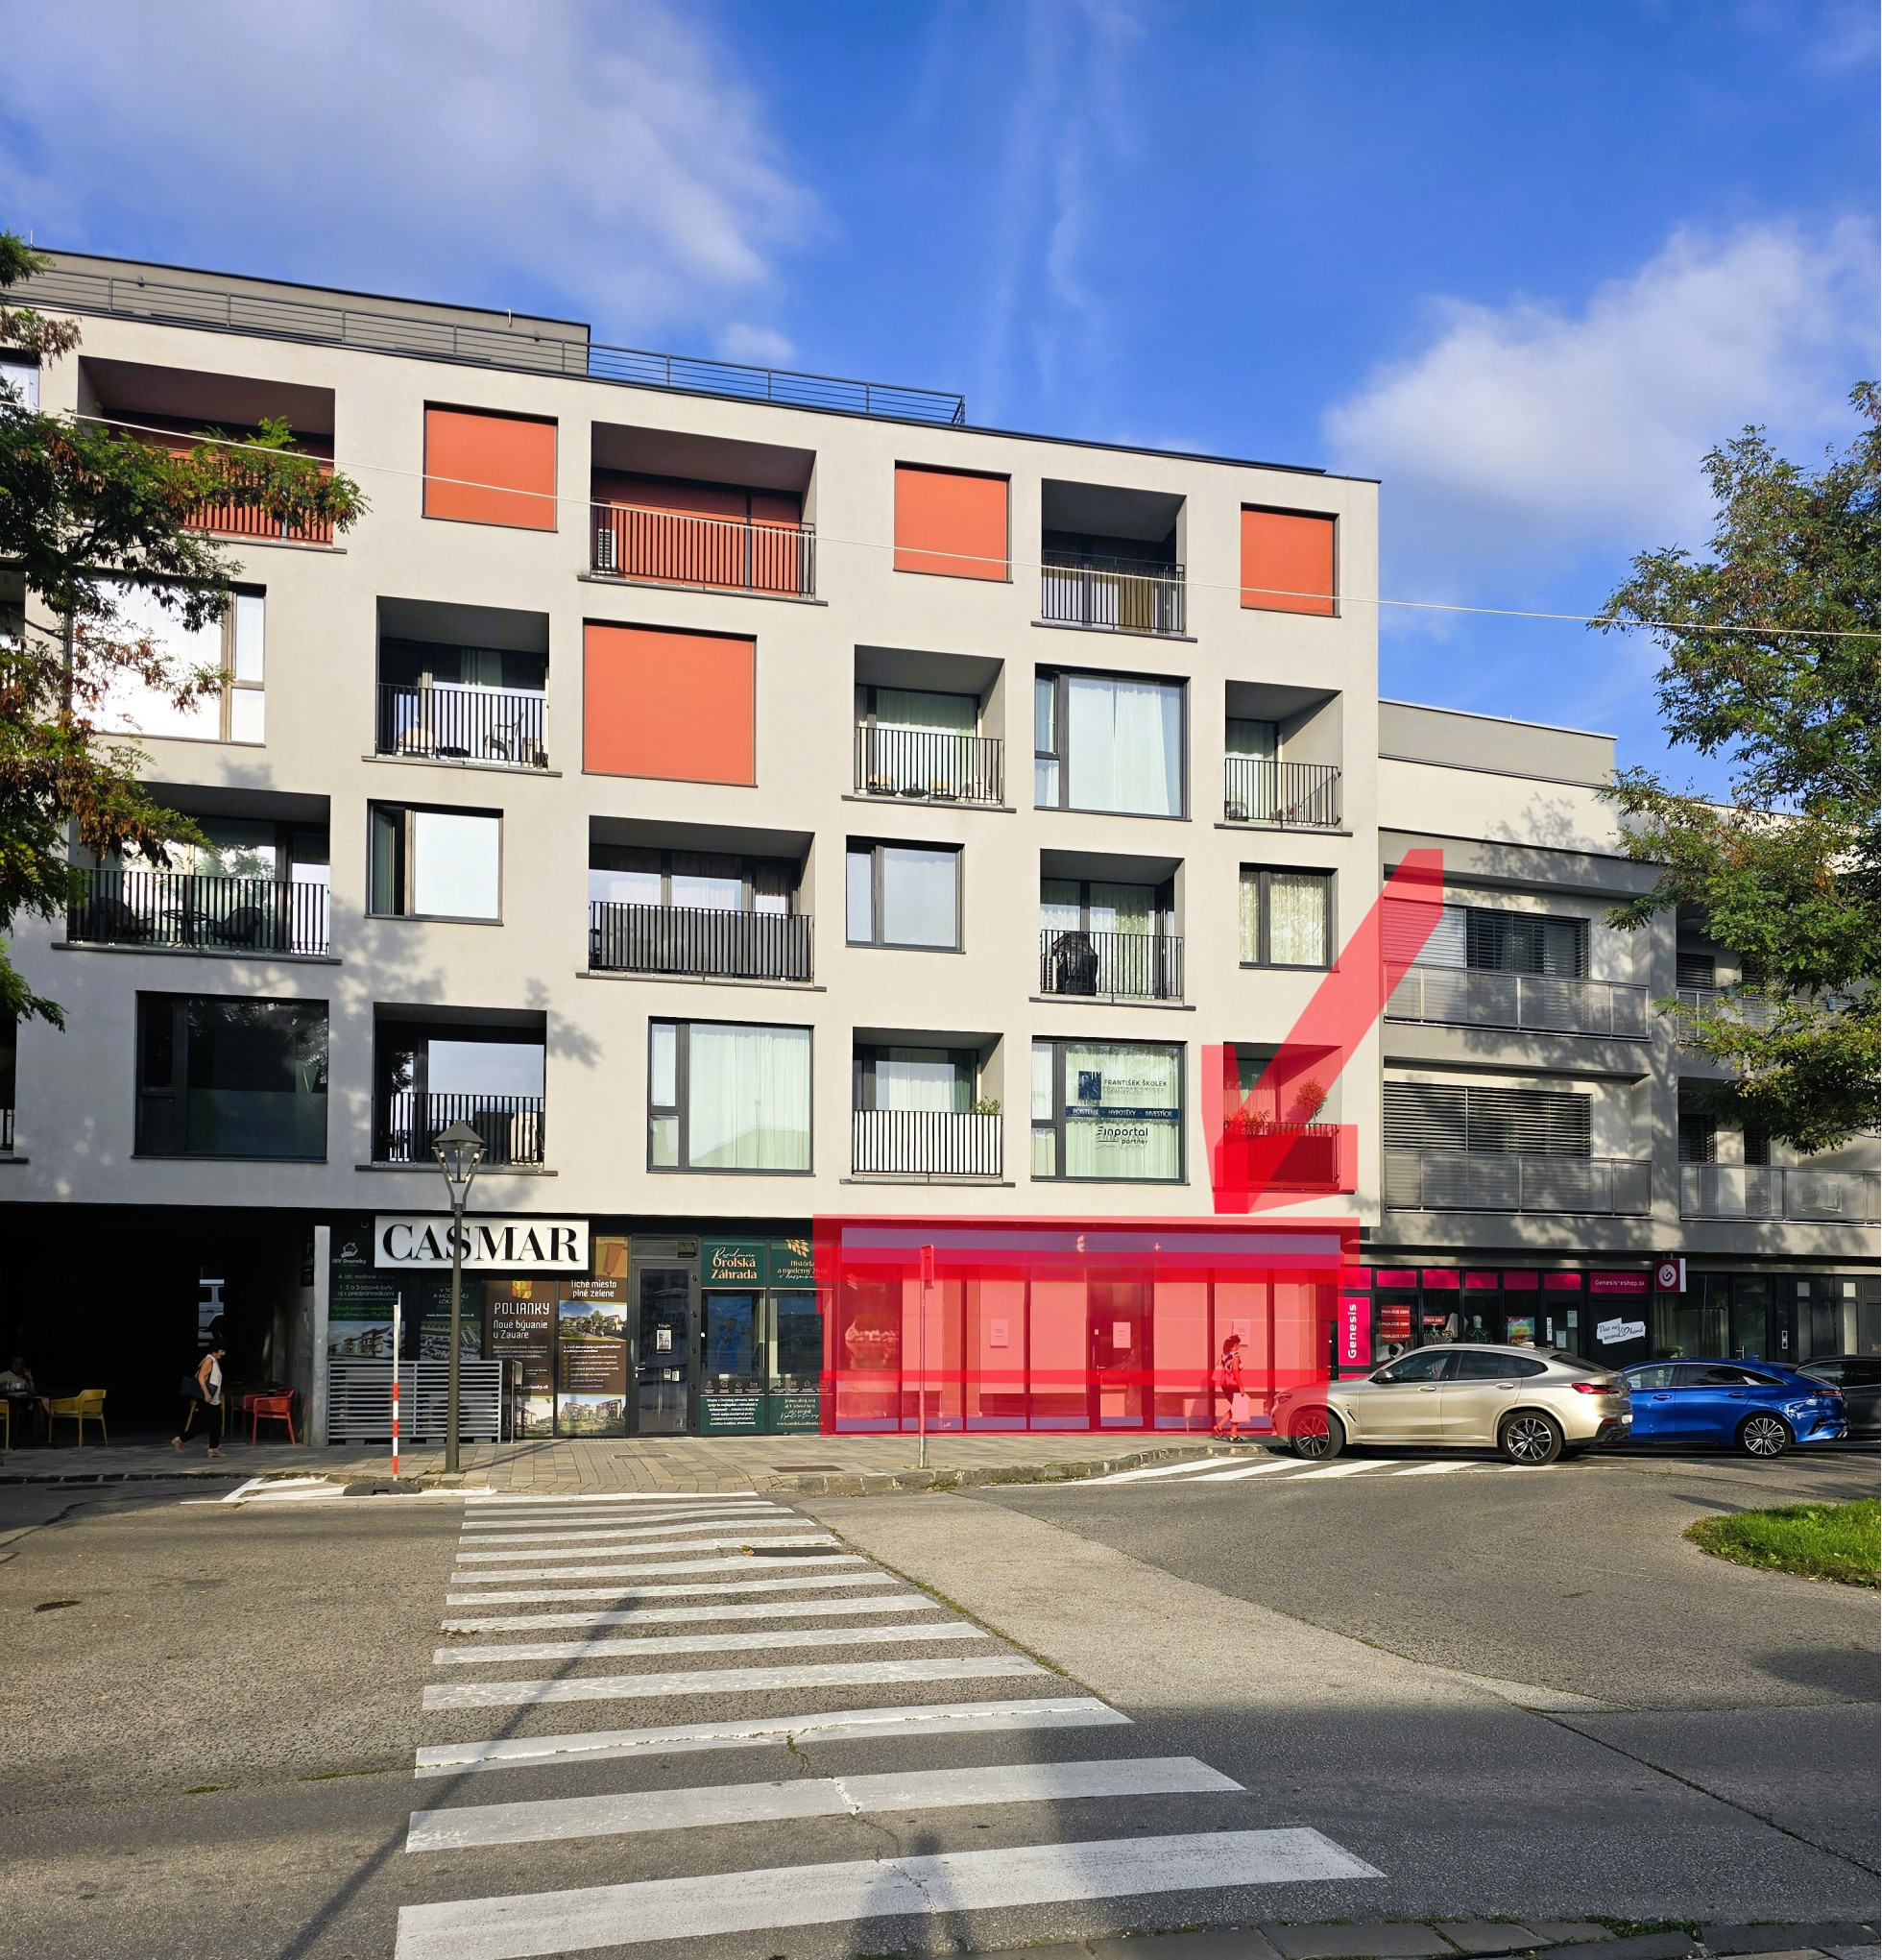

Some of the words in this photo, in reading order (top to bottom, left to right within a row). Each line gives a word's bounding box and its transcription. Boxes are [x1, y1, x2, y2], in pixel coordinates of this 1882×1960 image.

[1142, 1078, 1168, 1087] ŠKOLEK
[382, 1223, 580, 1263] CASMAR
[712, 1257, 757, 1268] Orolská
[711, 1269, 758, 1280] Záhrada
[784, 1267, 811, 1275] moderný
[571, 1280, 591, 1289] Tiché
[591, 1280, 617, 1289] miesto
[572, 1290, 589, 1298] plné
[590, 1289, 615, 1297] zelene
[494, 1302, 550, 1316] POLIANKY
[493, 1319, 514, 1329] Nové
[516, 1319, 548, 1331] bývanie
[1629, 1324, 1644, 1334] hand
[500, 1330, 529, 1340] Zavare
[1347, 1303, 1357, 1359] Genesis
